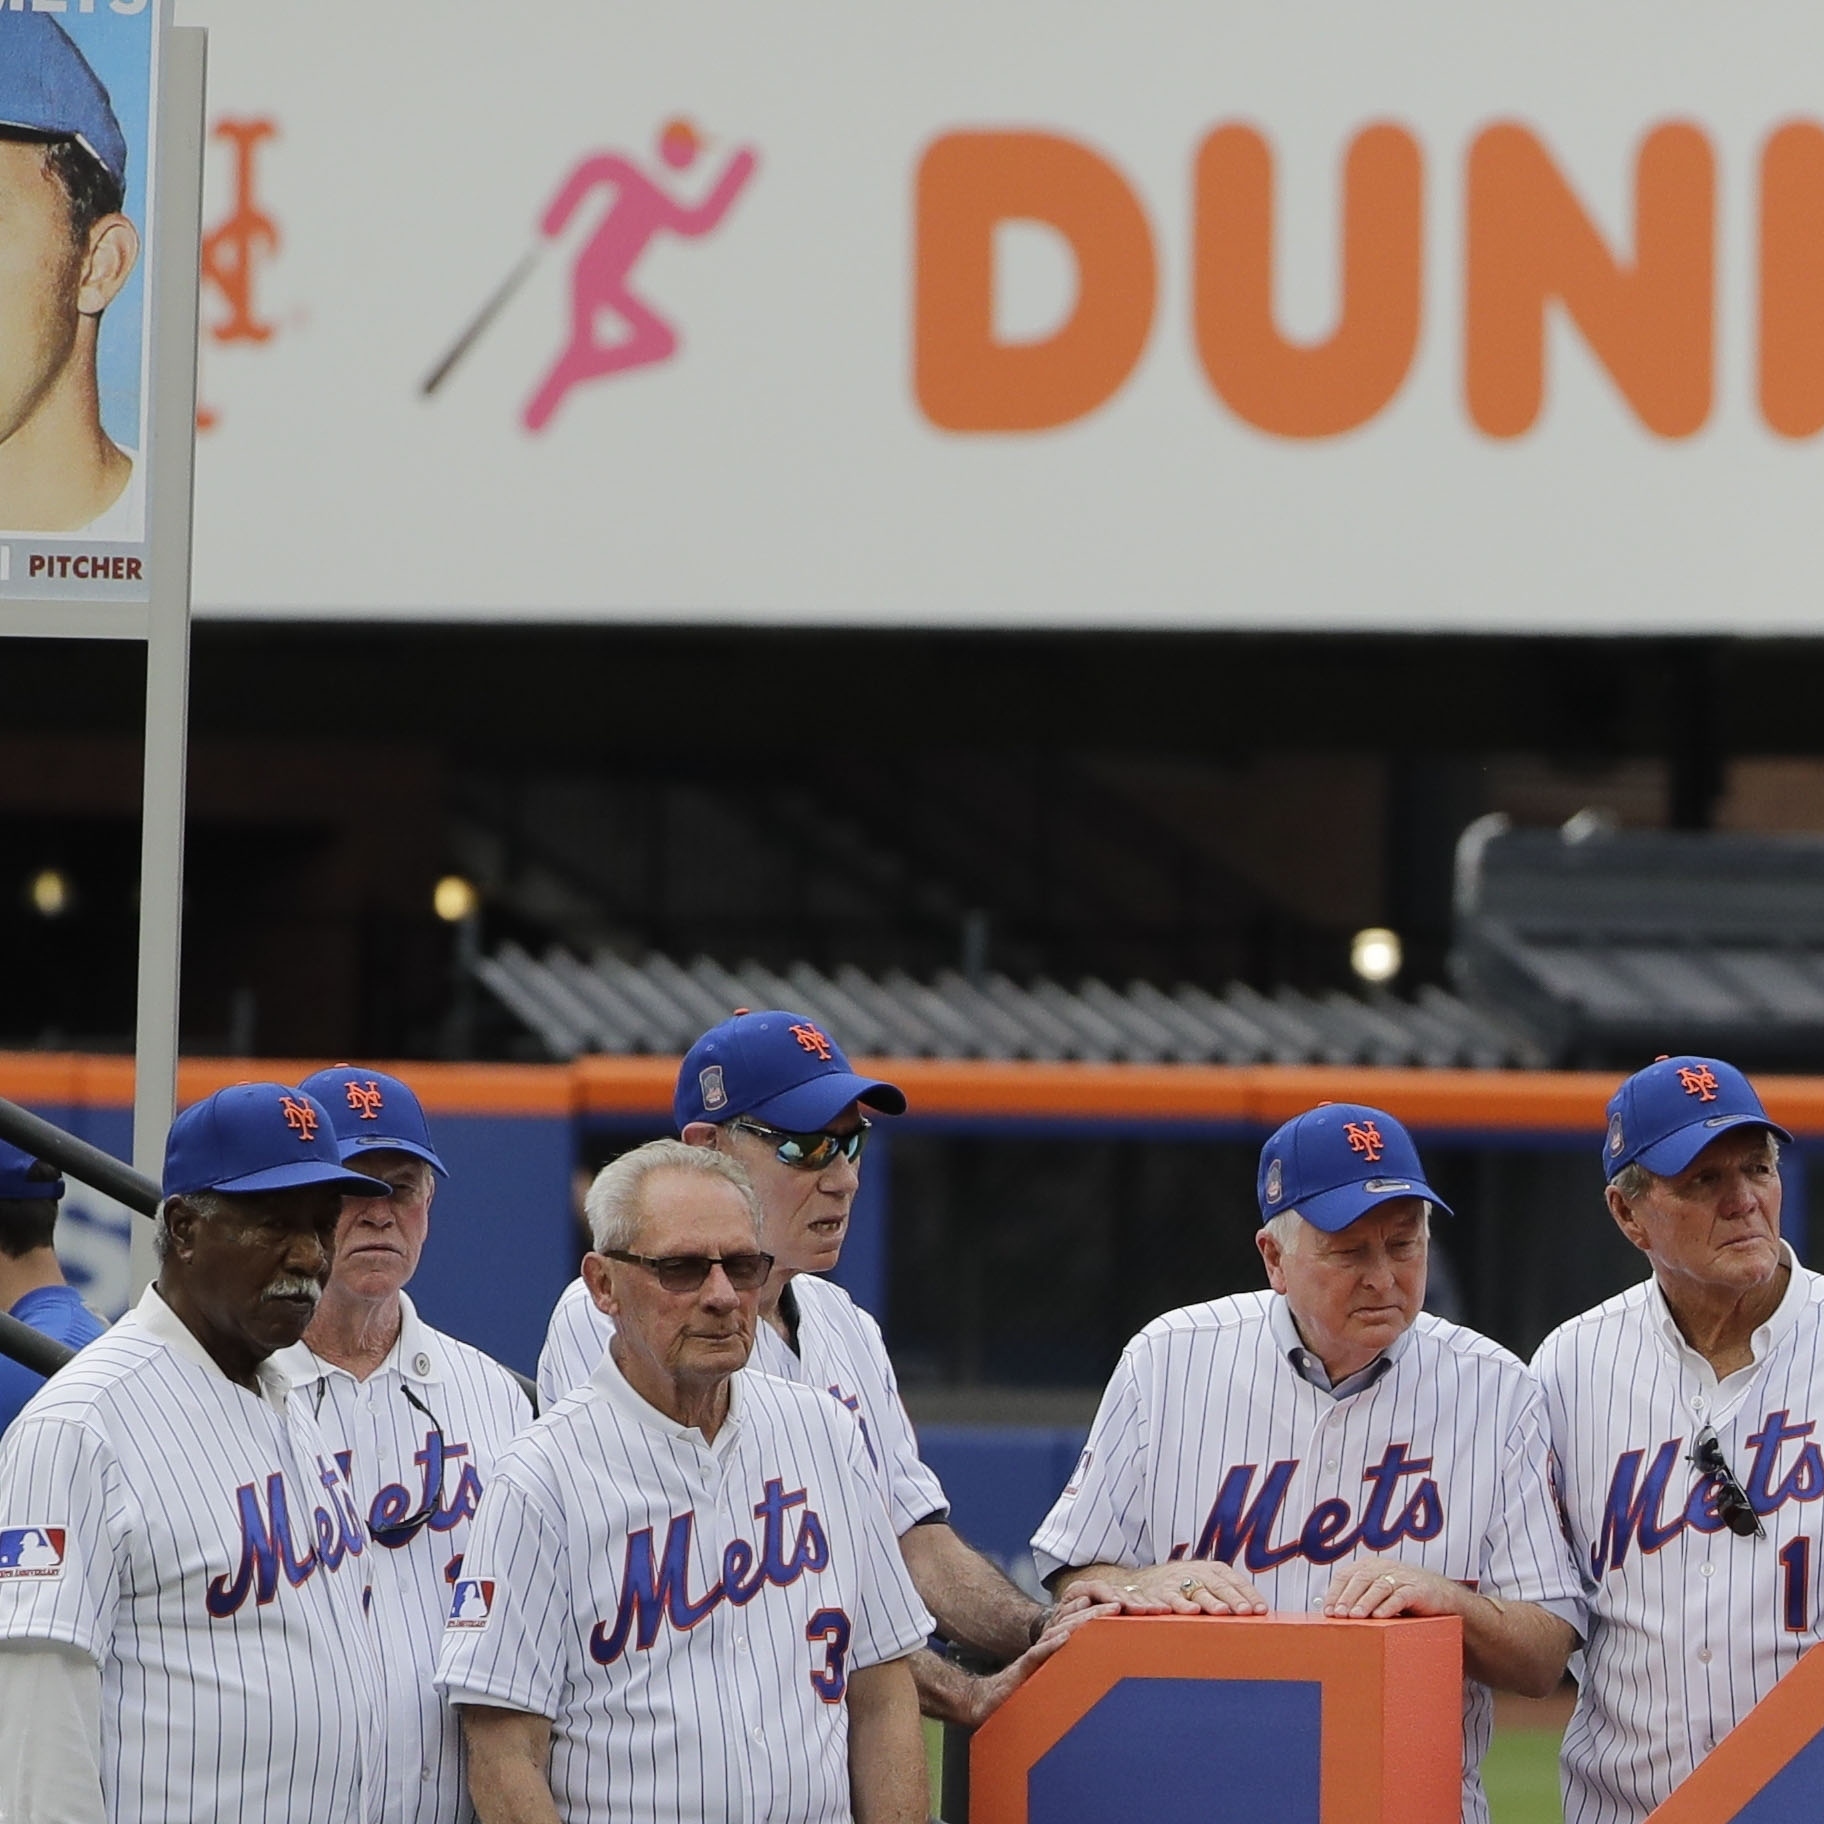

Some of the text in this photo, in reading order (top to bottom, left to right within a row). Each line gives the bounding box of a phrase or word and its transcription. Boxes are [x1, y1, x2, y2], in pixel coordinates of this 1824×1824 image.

[29, 554, 143, 580] PITCHER
[1173, 1443, 1445, 1573] Mets
[590, 1477, 831, 1665] Mets
[805, 1607, 852, 1705] 3
